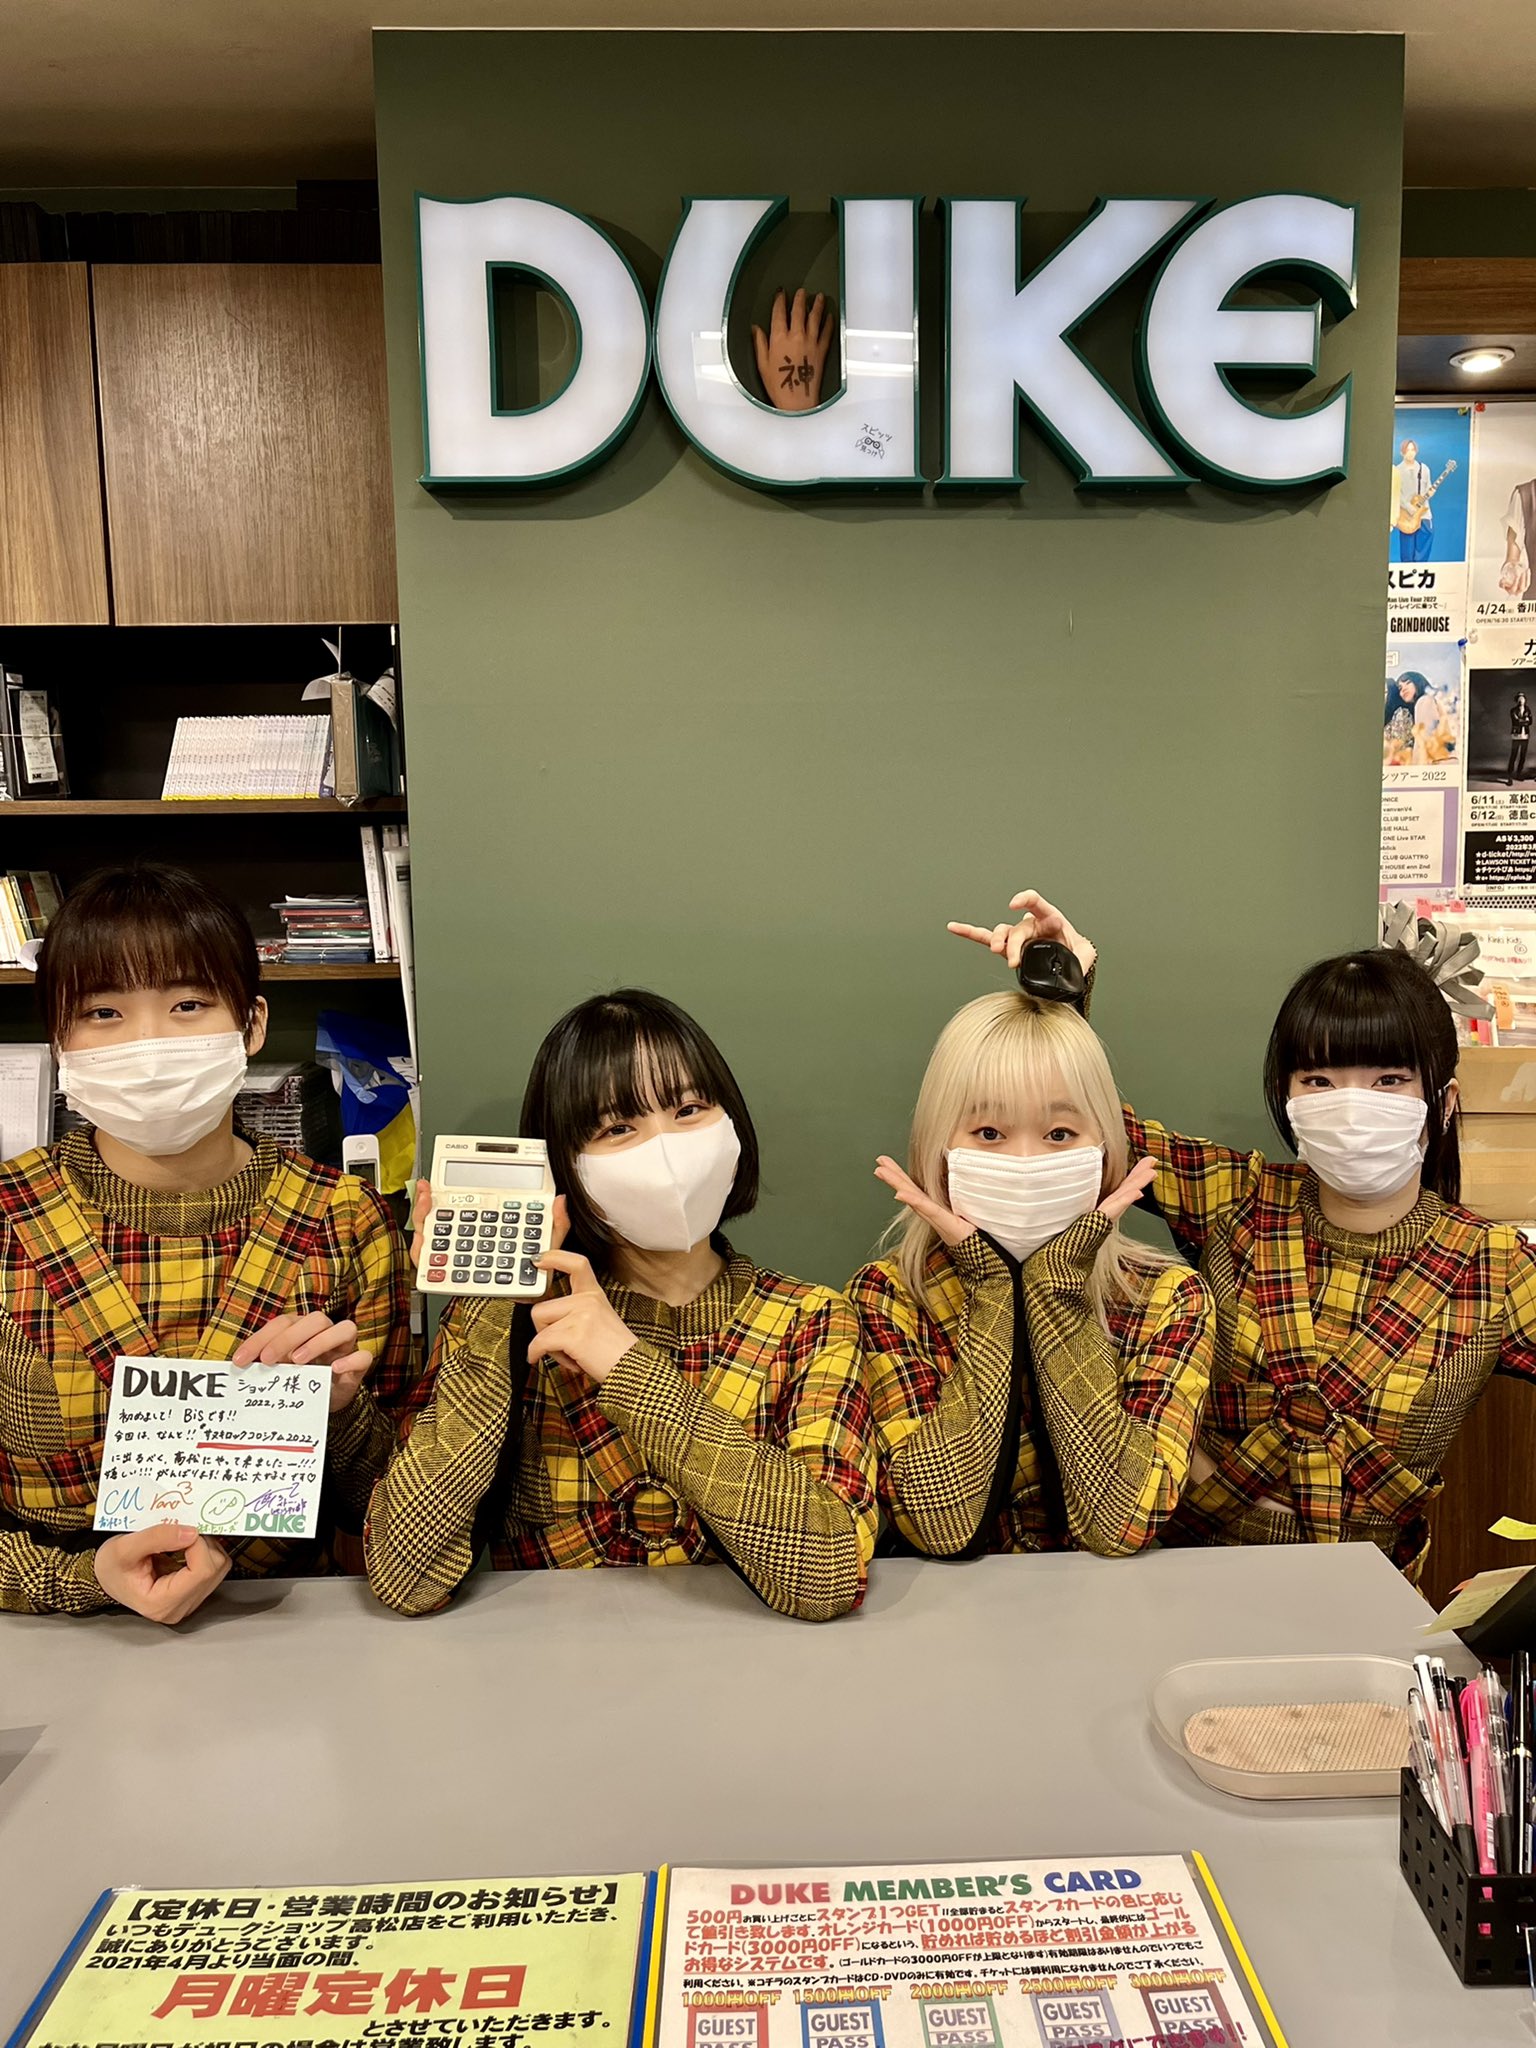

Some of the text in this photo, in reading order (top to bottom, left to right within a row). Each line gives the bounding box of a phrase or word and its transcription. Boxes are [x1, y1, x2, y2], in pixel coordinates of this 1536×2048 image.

[415, 193, 1359, 489] DUKE
[778, 354, 816, 398] 神
[1390, 616, 1450, 633] GRINDHOUSE
[1422, 771, 1447, 781] 2022
[463, 1226, 470, 1234] 7
[483, 1226, 491, 1235] 8
[505, 1227, 513, 1236] 9
[460, 1240, 468, 1248] 4
[482, 1241, 490, 1250] 5
[503, 1242, 511, 1251] 6
[433, 1255, 442, 1263] C
[480, 1256, 488, 1265] 2
[502, 1257, 510, 1266] 3
[456, 1271, 464, 1280] 0
[122, 1365, 229, 1401] DUKE
[244, 1513, 307, 1534] DUKE
[730, 1869, 1142, 1906] DUKE MEMBER'S CARD
[94, 1934, 375, 1955] 誠にありがとうございます。
[150, 1964, 528, 2019] 月曜定休日
[682, 1967, 1228, 2008] 1000円OFF 1500円OFF 2000円OFF 2500円OFF 3000円OFF
[362, 2010, 612, 2037] とさせていただきます。
[697, 1994, 1213, 2036] GUEST GUEST GUEST GUEST GUEST
[936, 2030, 988, 2045] PASS
[1052, 2024, 1105, 2039] PASS
